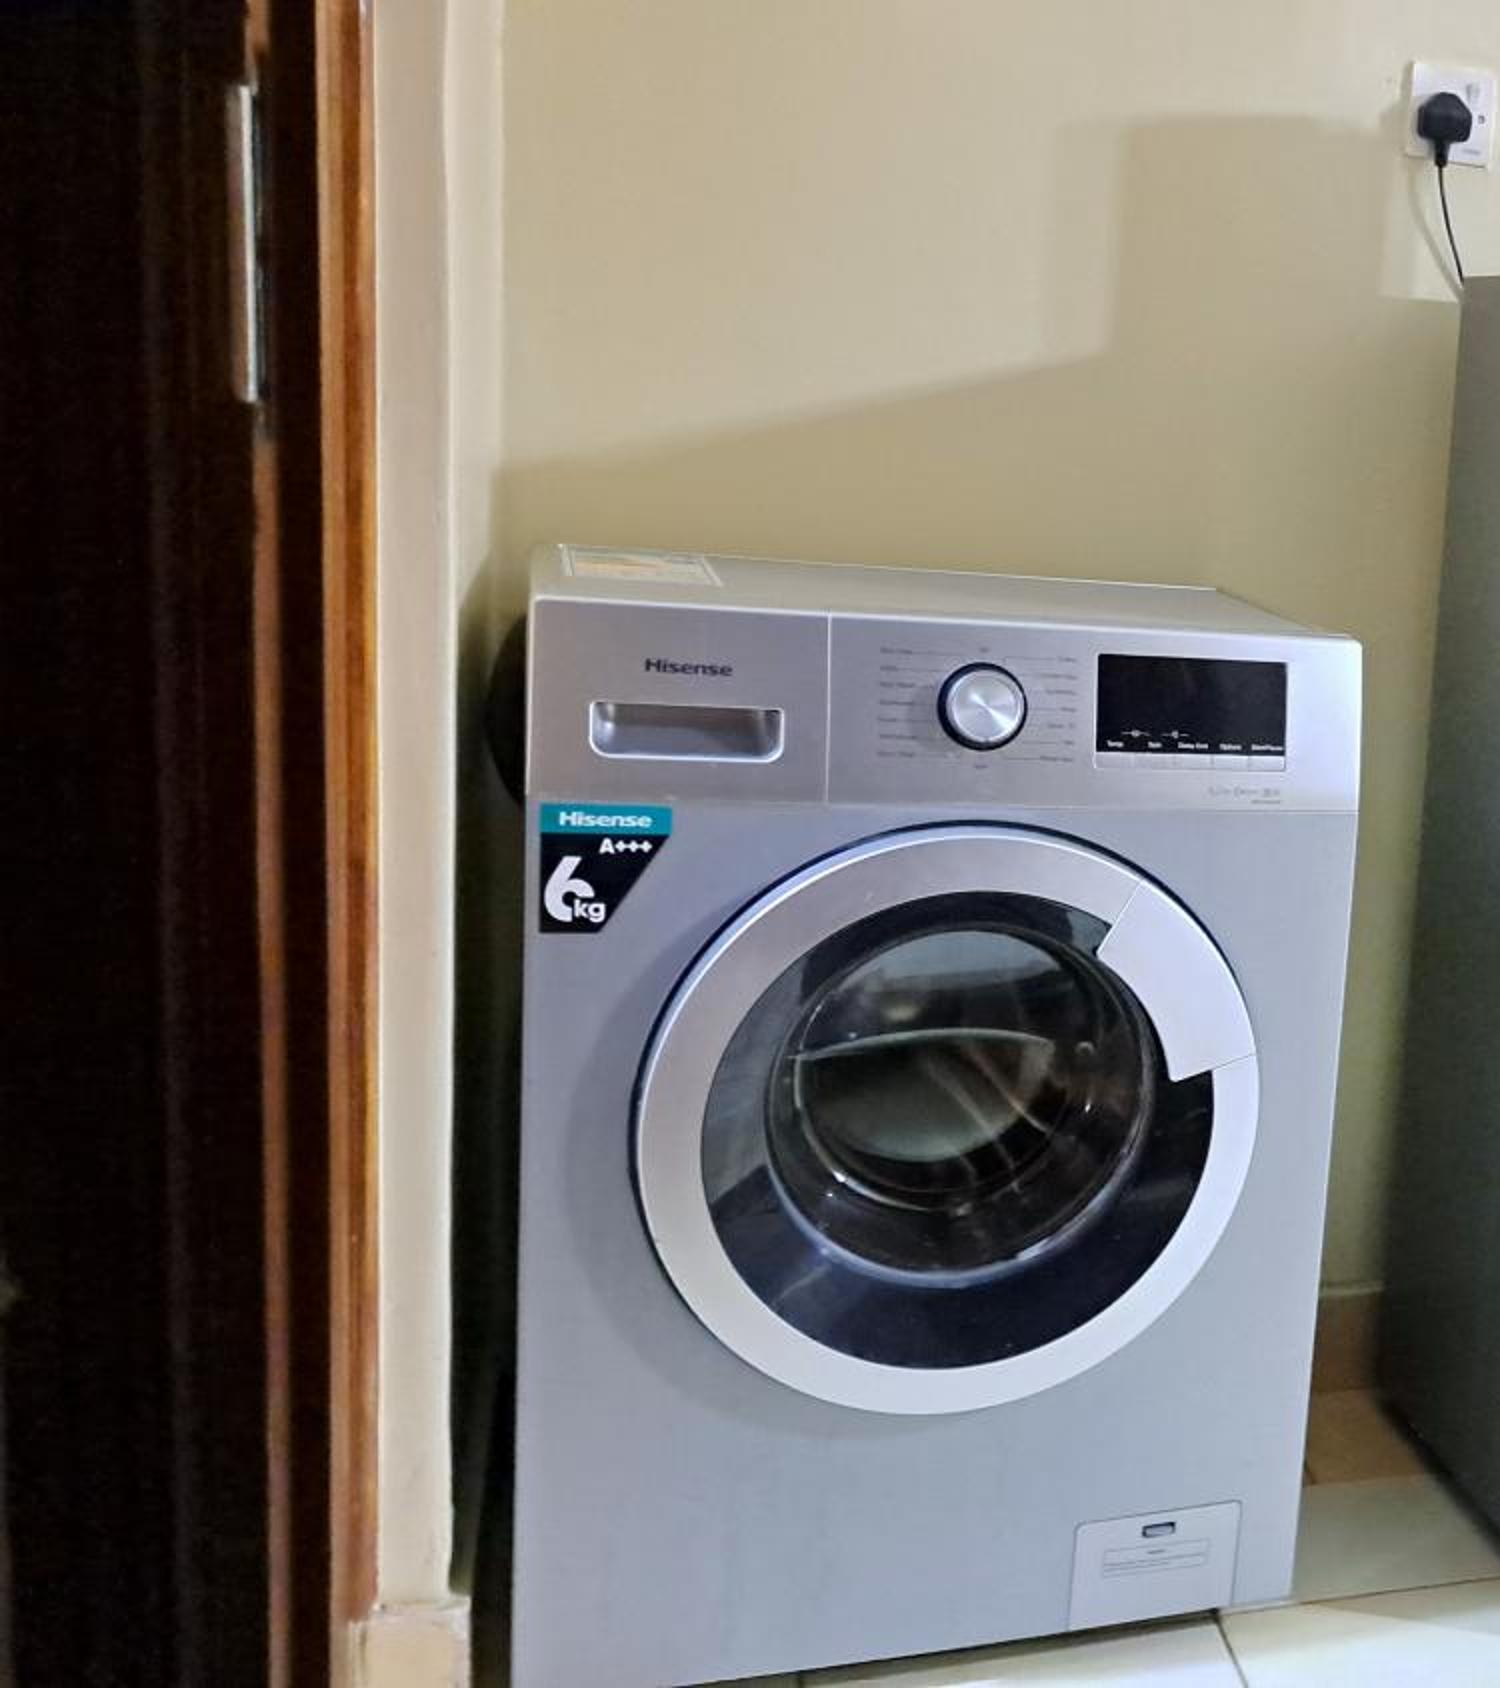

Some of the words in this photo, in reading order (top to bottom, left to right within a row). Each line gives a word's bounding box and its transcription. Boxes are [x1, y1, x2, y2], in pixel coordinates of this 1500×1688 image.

[645, 658, 733, 677] Hisense
[559, 811, 653, 828] Hisense
[599, 837, 653, 855] A+++
